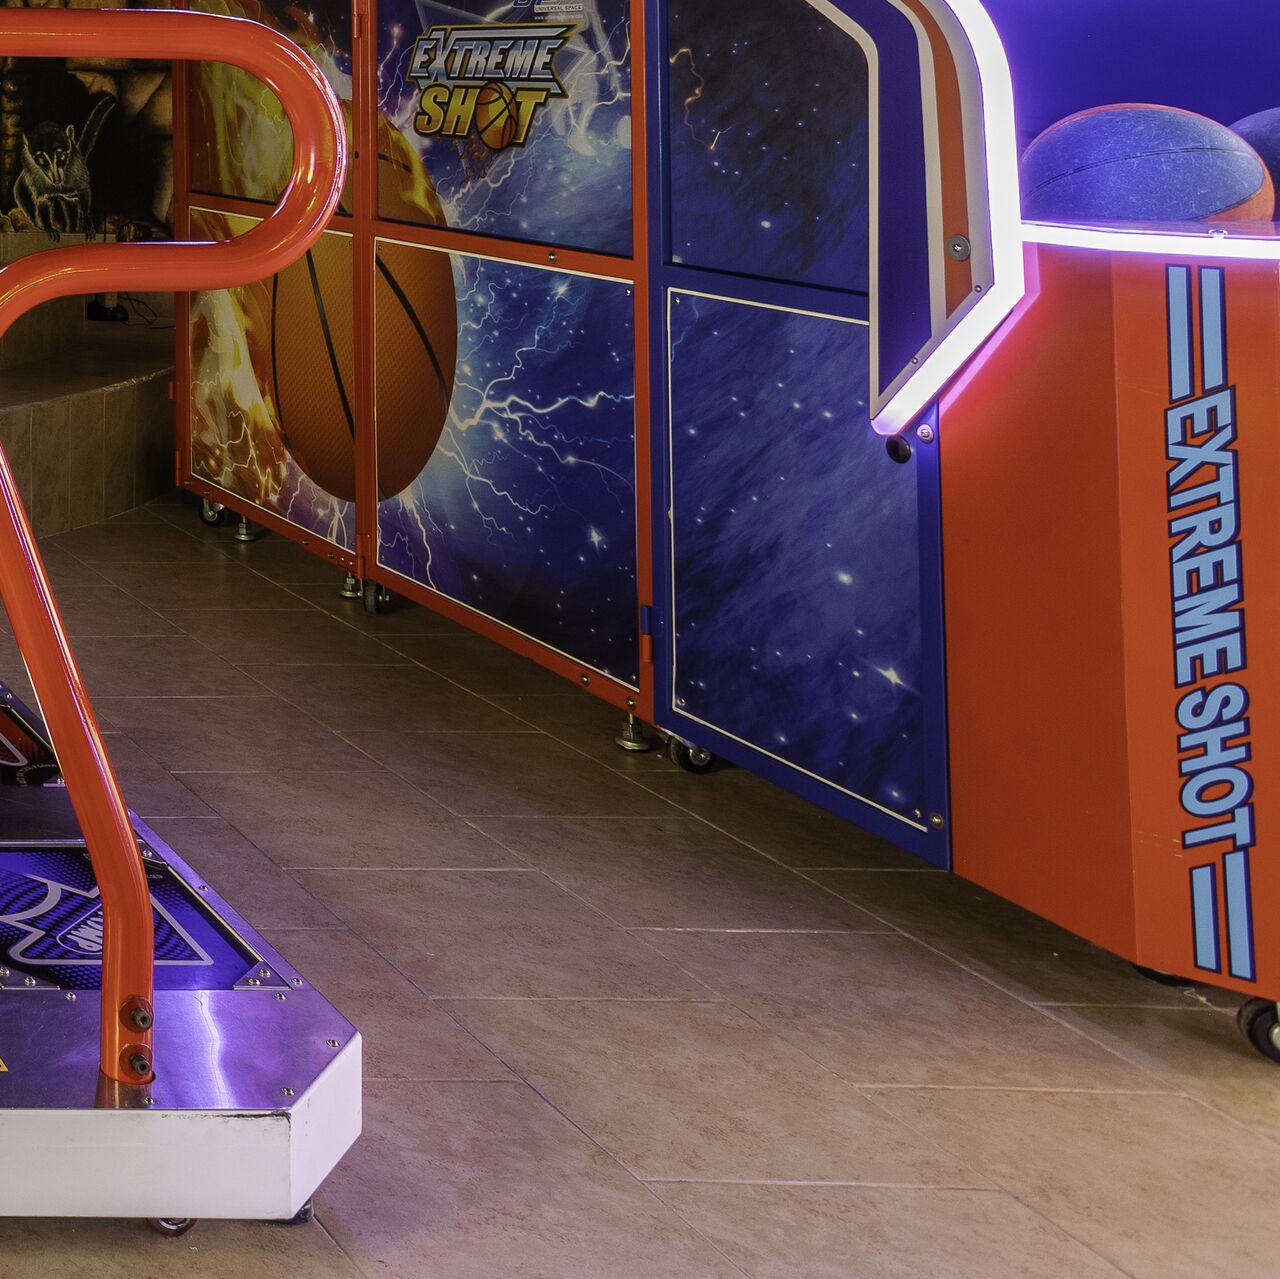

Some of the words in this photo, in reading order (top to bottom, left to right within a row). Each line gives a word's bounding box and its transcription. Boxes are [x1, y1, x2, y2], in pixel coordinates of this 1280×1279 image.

[409, 28, 566, 81] EXTREME
[414, 82, 550, 150] SHOT
[1165, 385, 1247, 688] EXTREME
[1175, 682, 1255, 848] SHOT
